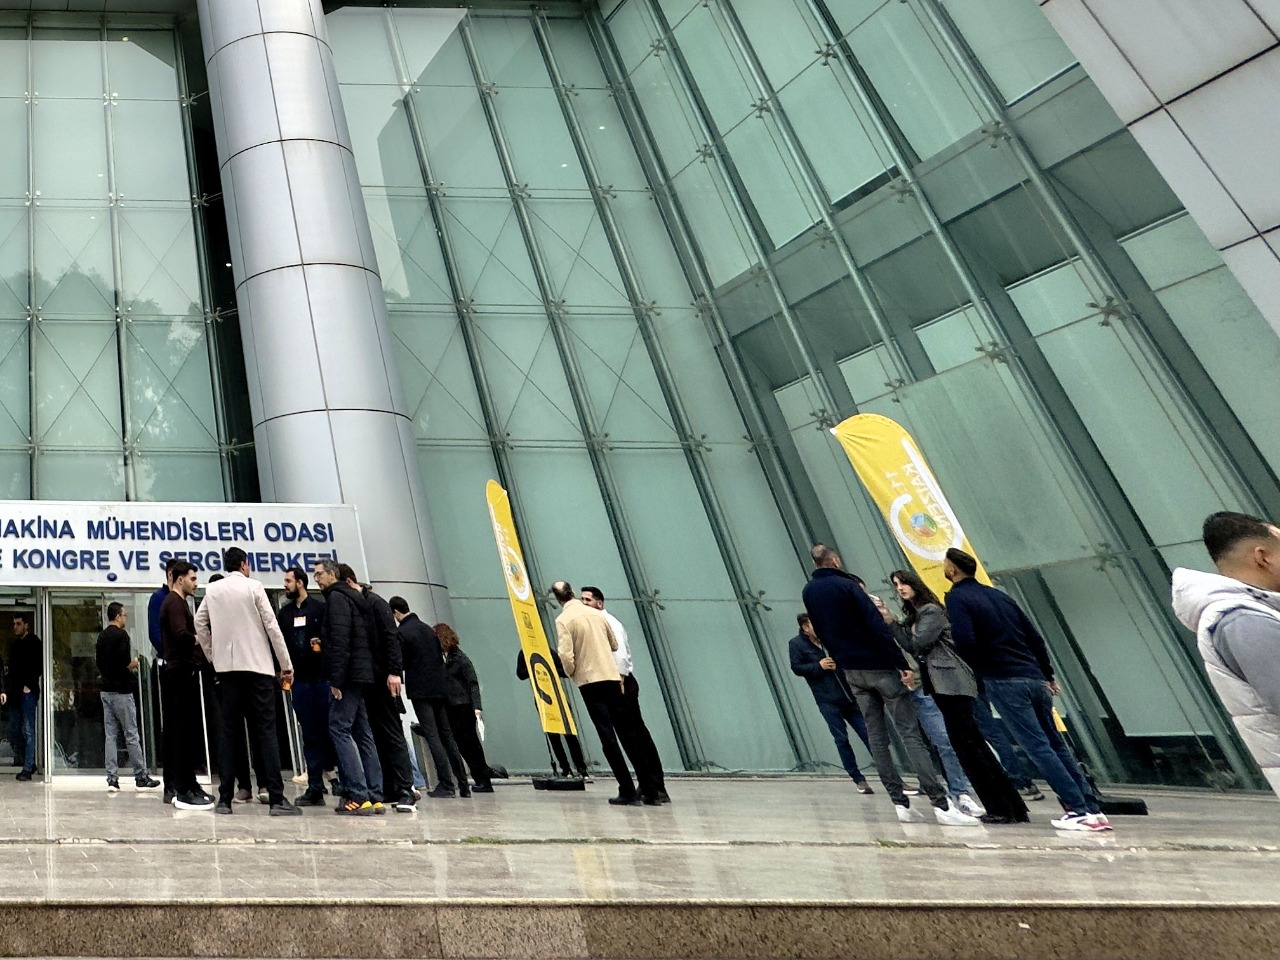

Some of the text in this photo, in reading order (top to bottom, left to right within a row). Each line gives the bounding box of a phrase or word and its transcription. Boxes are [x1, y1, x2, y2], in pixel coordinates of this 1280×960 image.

[87, 516, 255, 542] MÜHENDİSLERİ
[263, 522, 335, 542] ODASI
[13, 548, 111, 570] KONGRE
[118, 550, 150, 571] VE
